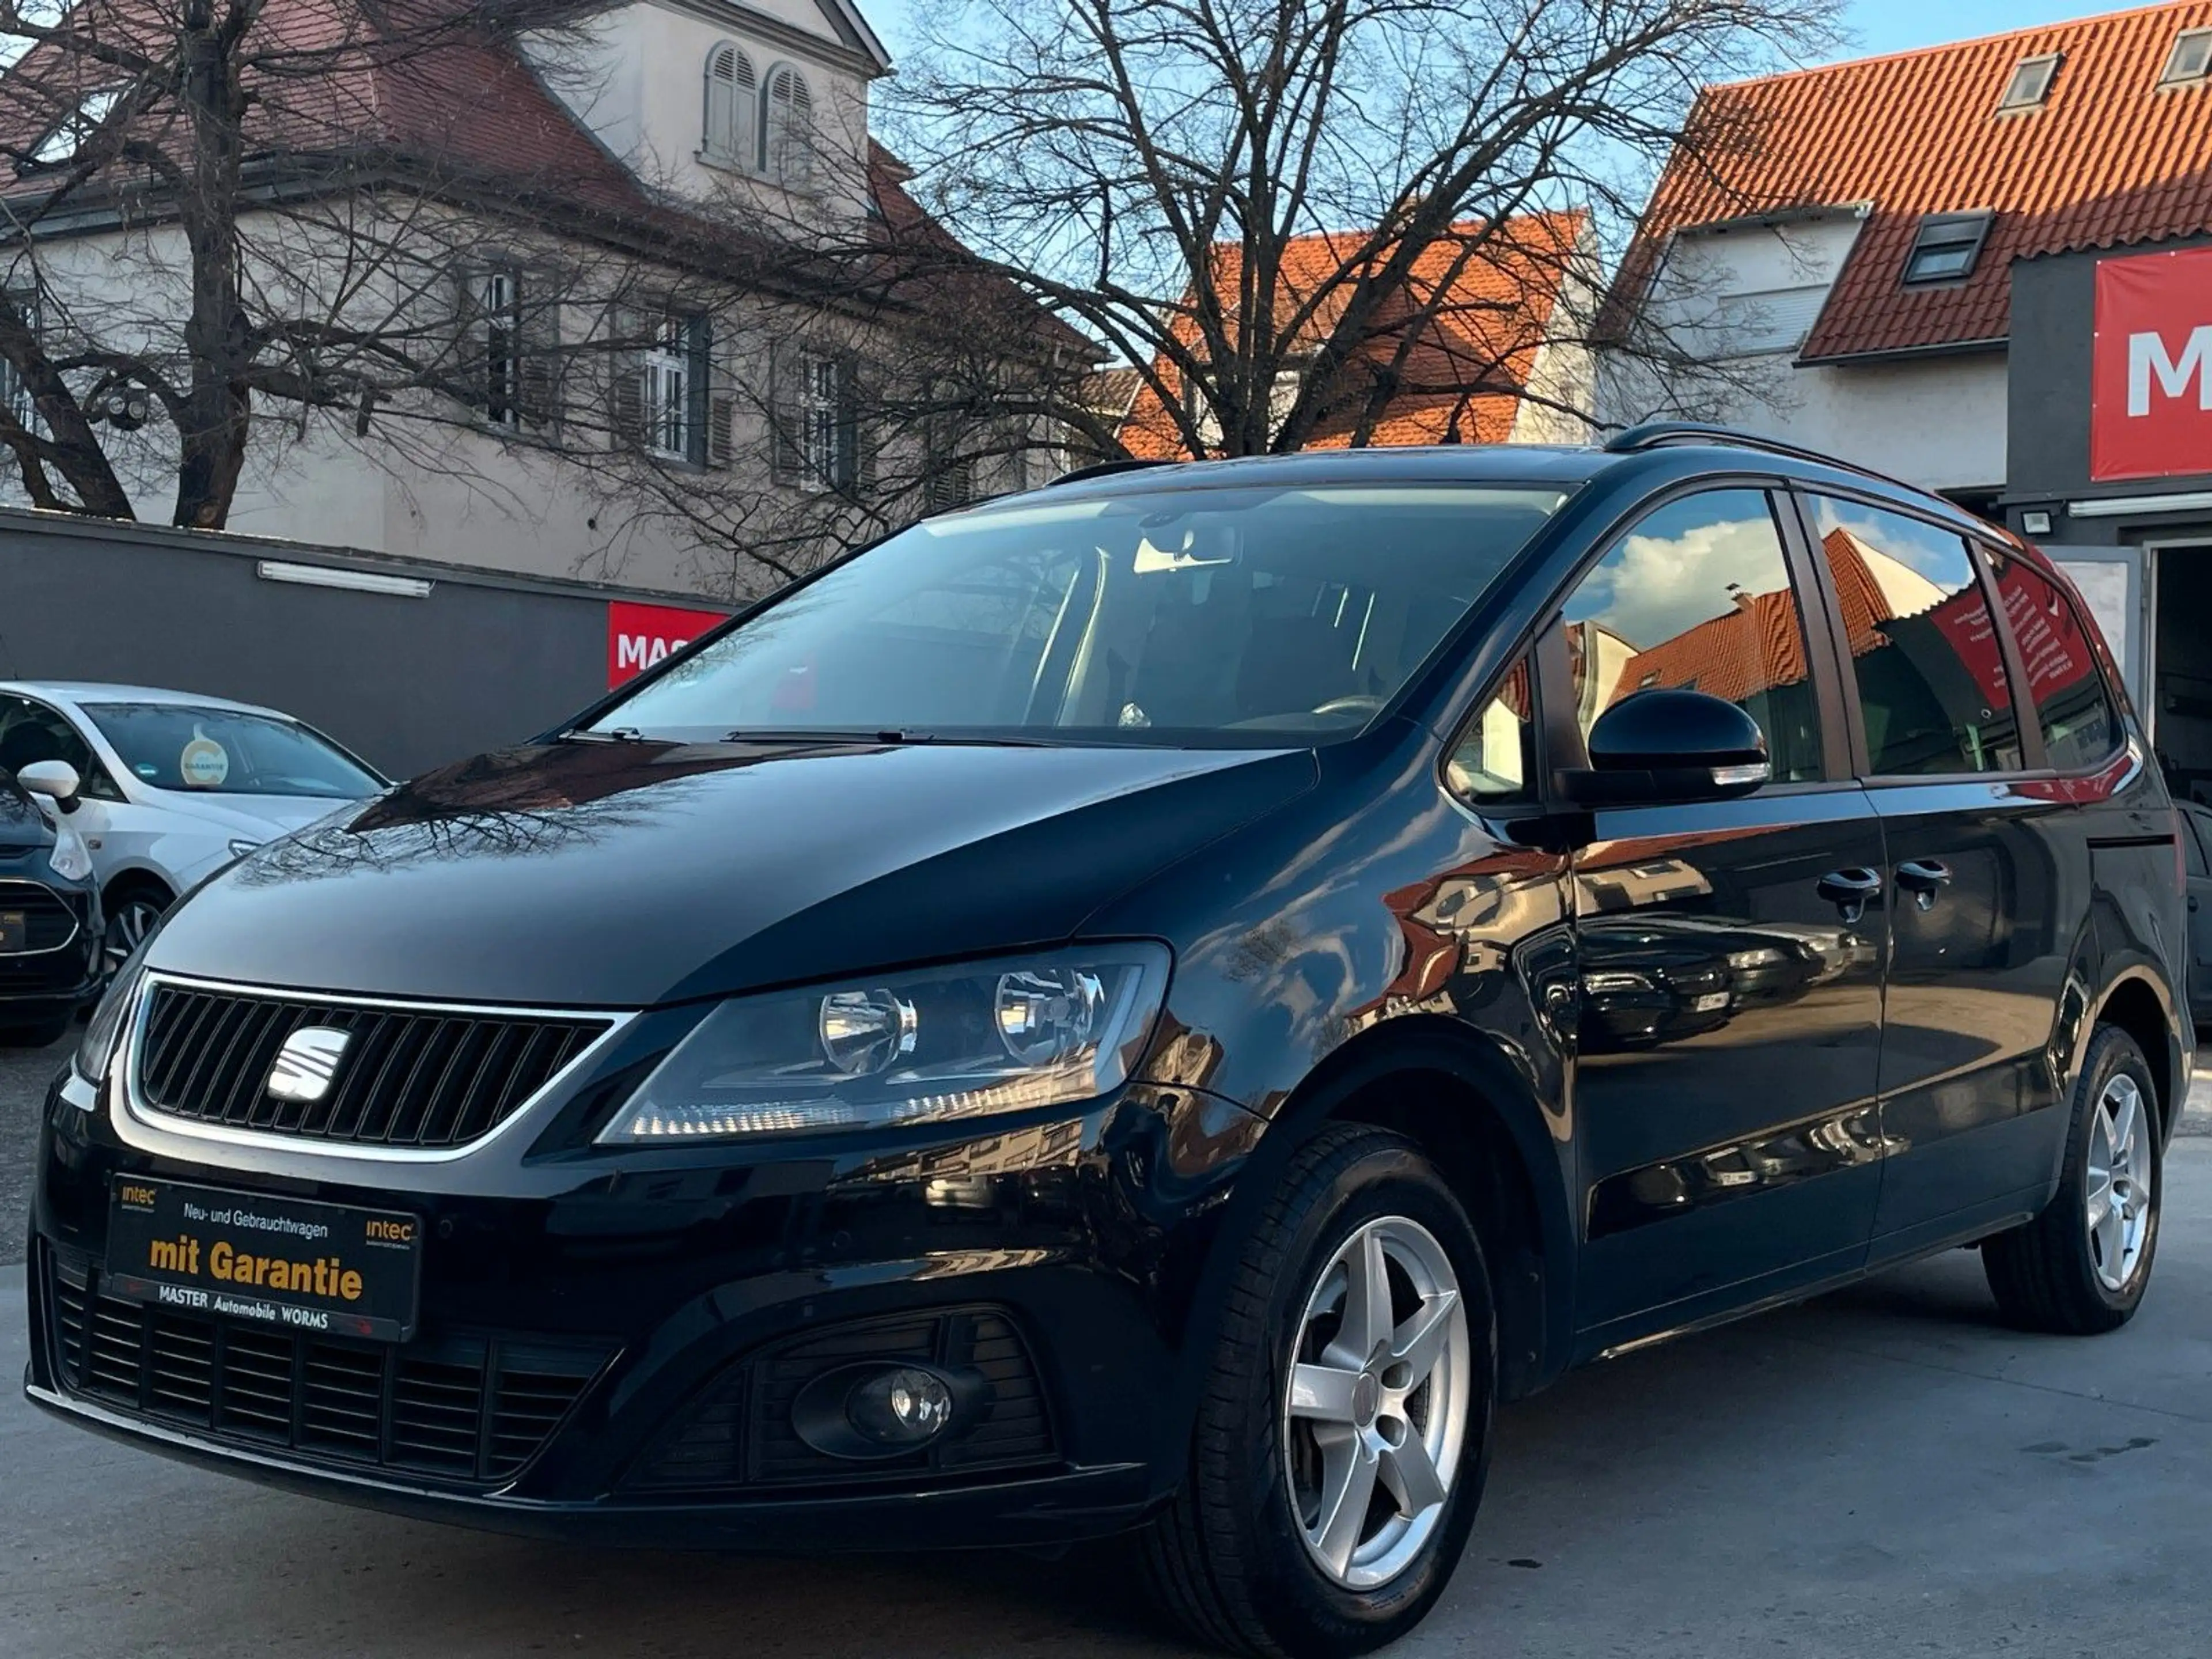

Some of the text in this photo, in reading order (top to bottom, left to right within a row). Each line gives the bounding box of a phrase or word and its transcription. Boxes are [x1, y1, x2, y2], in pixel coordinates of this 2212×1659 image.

[2127, 325, 2212, 417] M
[122, 1185, 156, 1205] intec
[183, 1202, 328, 1240] Neu- und Gebrauchtwagen
[366, 1219, 414, 1241] intec
[150, 1234, 363, 1301] mit Garantie
[159, 1285, 329, 1329] MASTER Automobile WORMS
